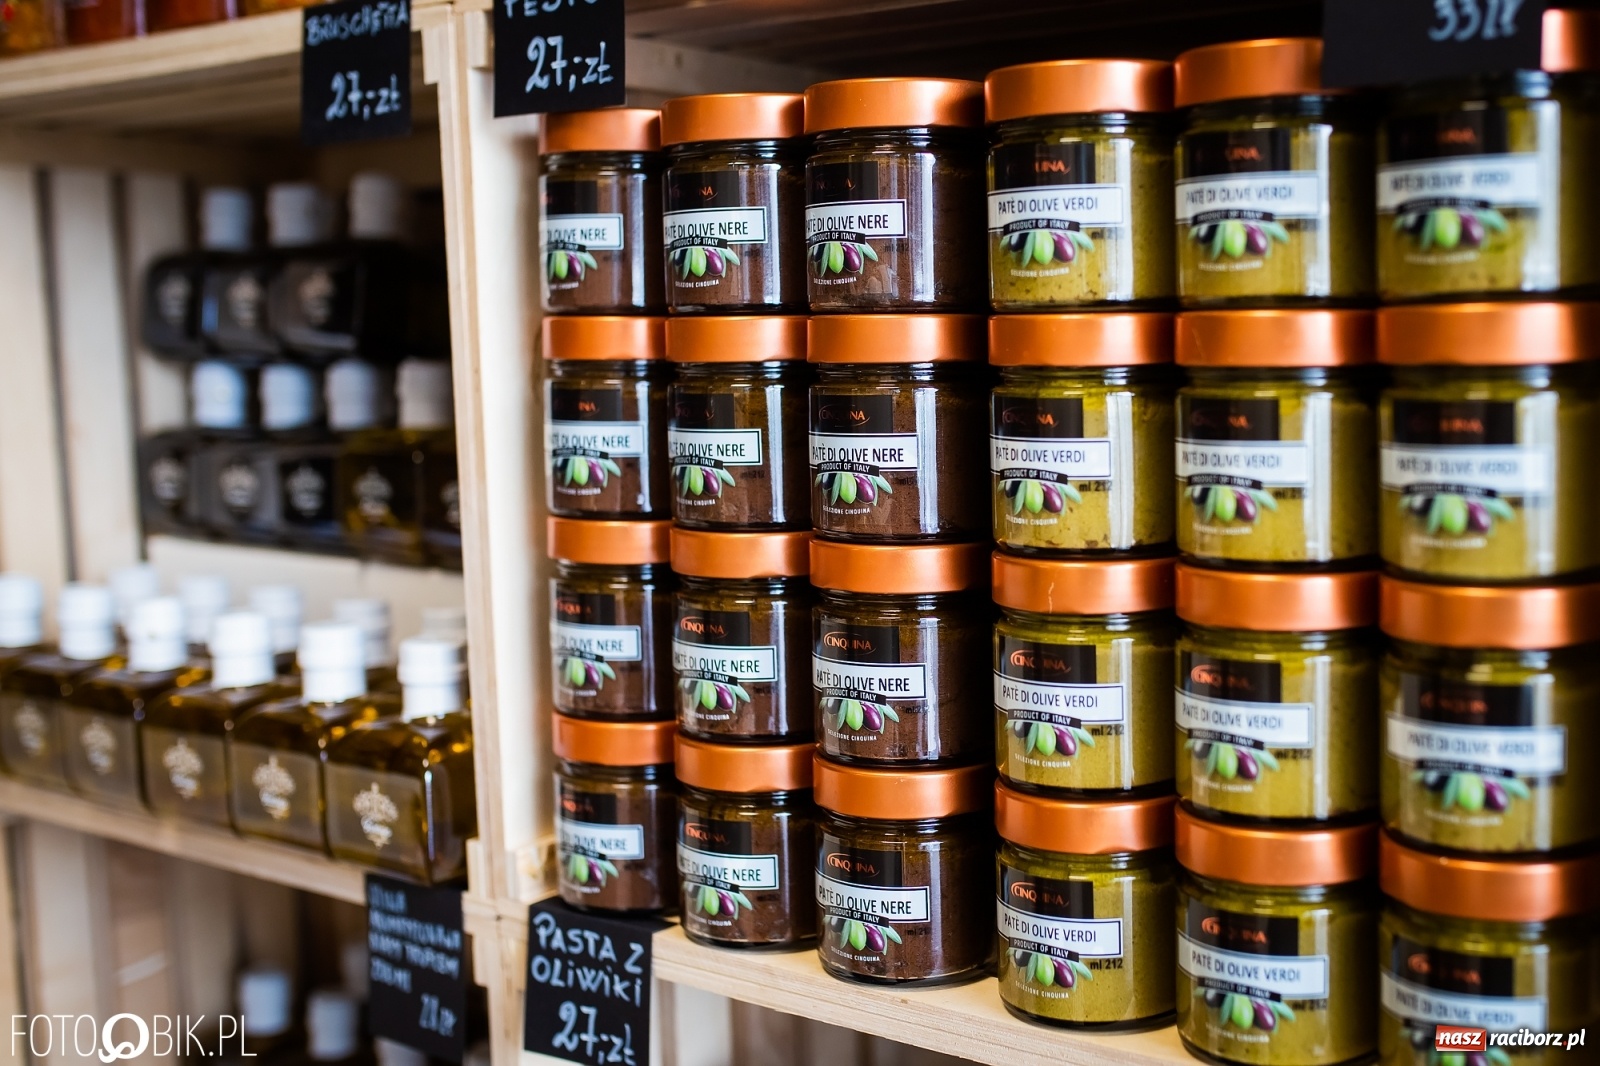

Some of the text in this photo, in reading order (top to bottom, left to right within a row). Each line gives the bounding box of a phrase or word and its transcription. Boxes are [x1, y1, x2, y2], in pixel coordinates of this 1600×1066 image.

[997, 197, 1099, 216] PATÈ DI OLIVE VERDI
[688, 222, 715, 238] OLIVE
[719, 221, 749, 236] NERE
[817, 214, 889, 232] DI OLIVE NERE
[1008, 221, 1037, 231] PRODUCT
[1038, 220, 1047, 229] OF
[581, 228, 607, 241] NERE
[841, 231, 857, 241] ITALY
[601, 435, 631, 449] NERE
[688, 443, 713, 457] OLIVE
[717, 443, 745, 456] NERE
[827, 448, 836, 461] DI
[839, 448, 868, 462] OLIVE
[872, 448, 904, 462] NERE
[1011, 448, 1019, 461] DI
[1021, 448, 1048, 463] OLIVE
[1051, 449, 1085, 463] VERDI
[700, 458, 716, 467] ITALY
[821, 462, 871, 473] PRODUCT OF ITALY
[1028, 470, 1037, 478] OF
[1039, 471, 1058, 481] ITALY
[1079, 483, 1092, 491] ml
[596, 640, 623, 652] NERE
[826, 635, 872, 650] CINQINA
[689, 656, 697, 669] DI
[699, 657, 727, 673] OLIVE
[730, 660, 760, 673] NERE
[713, 673, 730, 683] ITALY
[816, 668, 910, 692] PATÈ DI OLIVE NERE
[826, 688, 877, 702] PRODUCT OF ITALY
[1002, 685, 1098, 708] PATÈ DI OLIVE VERDI
[1013, 710, 1071, 726] PRODUCT OF ITALY
[1212, 709, 1241, 727] OLIVE
[1245, 713, 1283, 729] VERDI
[1091, 723, 1125, 736] ml 212
[1042, 759, 1071, 768] CINQUINA
[702, 864, 728, 881] OLIVE
[732, 868, 762, 882] NERE
[829, 857, 876, 874] CINQINA
[818, 884, 912, 915] PATÈ DI OLIVE NERE
[1014, 885, 1064, 905] CINQINA
[829, 906, 880, 924] PRODUCT OF ITALY
[1004, 913, 1097, 942] PATÈ DI OLIVE VERDI
[532, 911, 644, 974] PASTA Z
[1013, 939, 1070, 959] PRODUCT OF ITALY
[854, 954, 881, 962] CINQUINA
[1090, 958, 1123, 971] ml 212
[1214, 958, 1225, 974] DI
[1227, 962, 1259, 980] OLIVE
[1263, 965, 1302, 981] VERDI
[1041, 989, 1070, 999] CINQUINA
